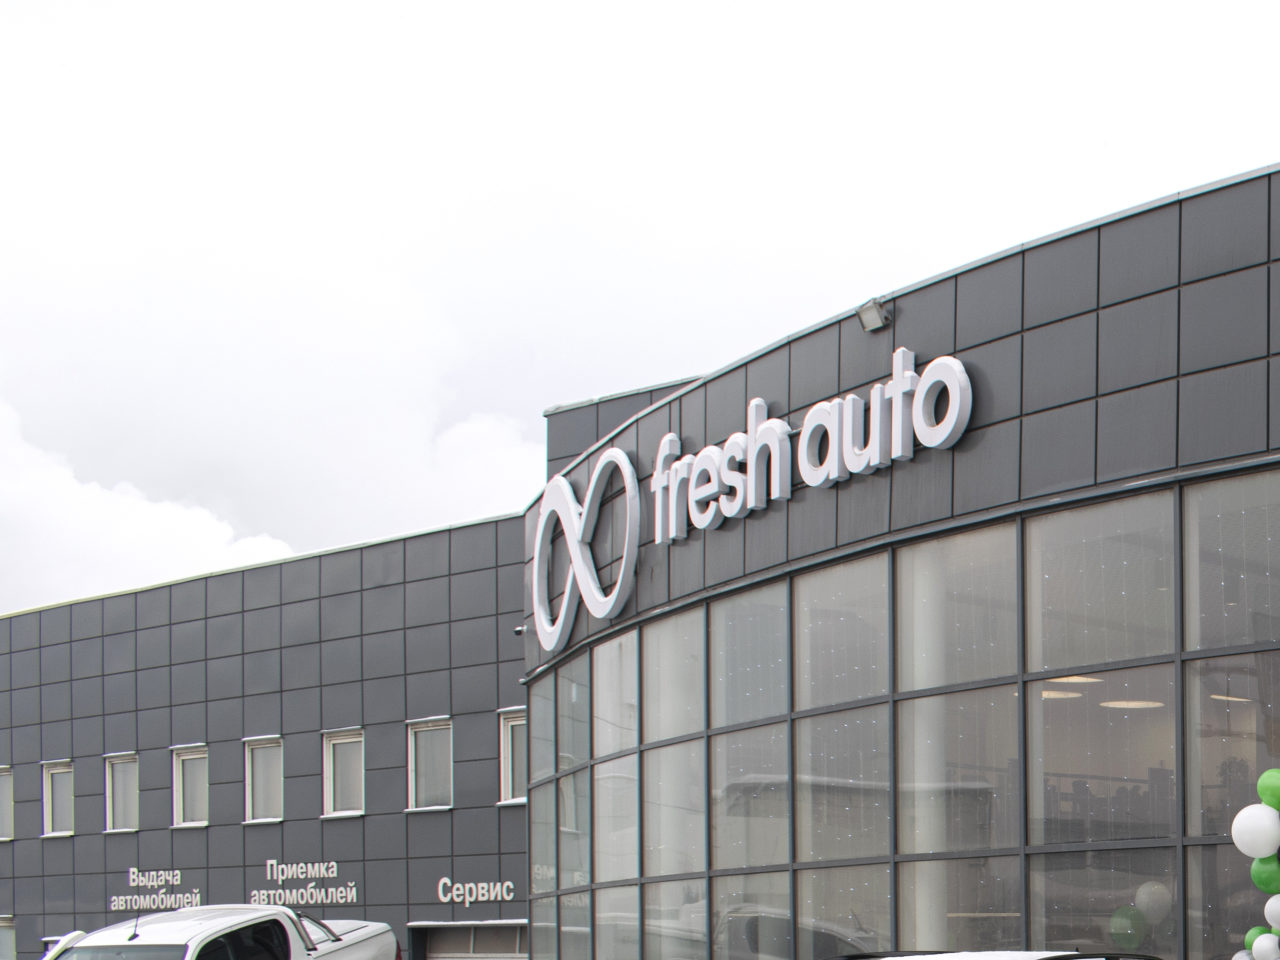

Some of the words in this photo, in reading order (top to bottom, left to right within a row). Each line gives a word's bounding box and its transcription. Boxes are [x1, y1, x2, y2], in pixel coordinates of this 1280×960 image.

[650, 397, 792, 545] fresh
[797, 346, 973, 488] auto
[129, 867, 181, 888] Выдача
[265, 859, 338, 885] Приемка
[110, 888, 201, 911] автомобилей
[251, 881, 357, 905] автомобилей
[438, 877, 515, 907] Сервис
